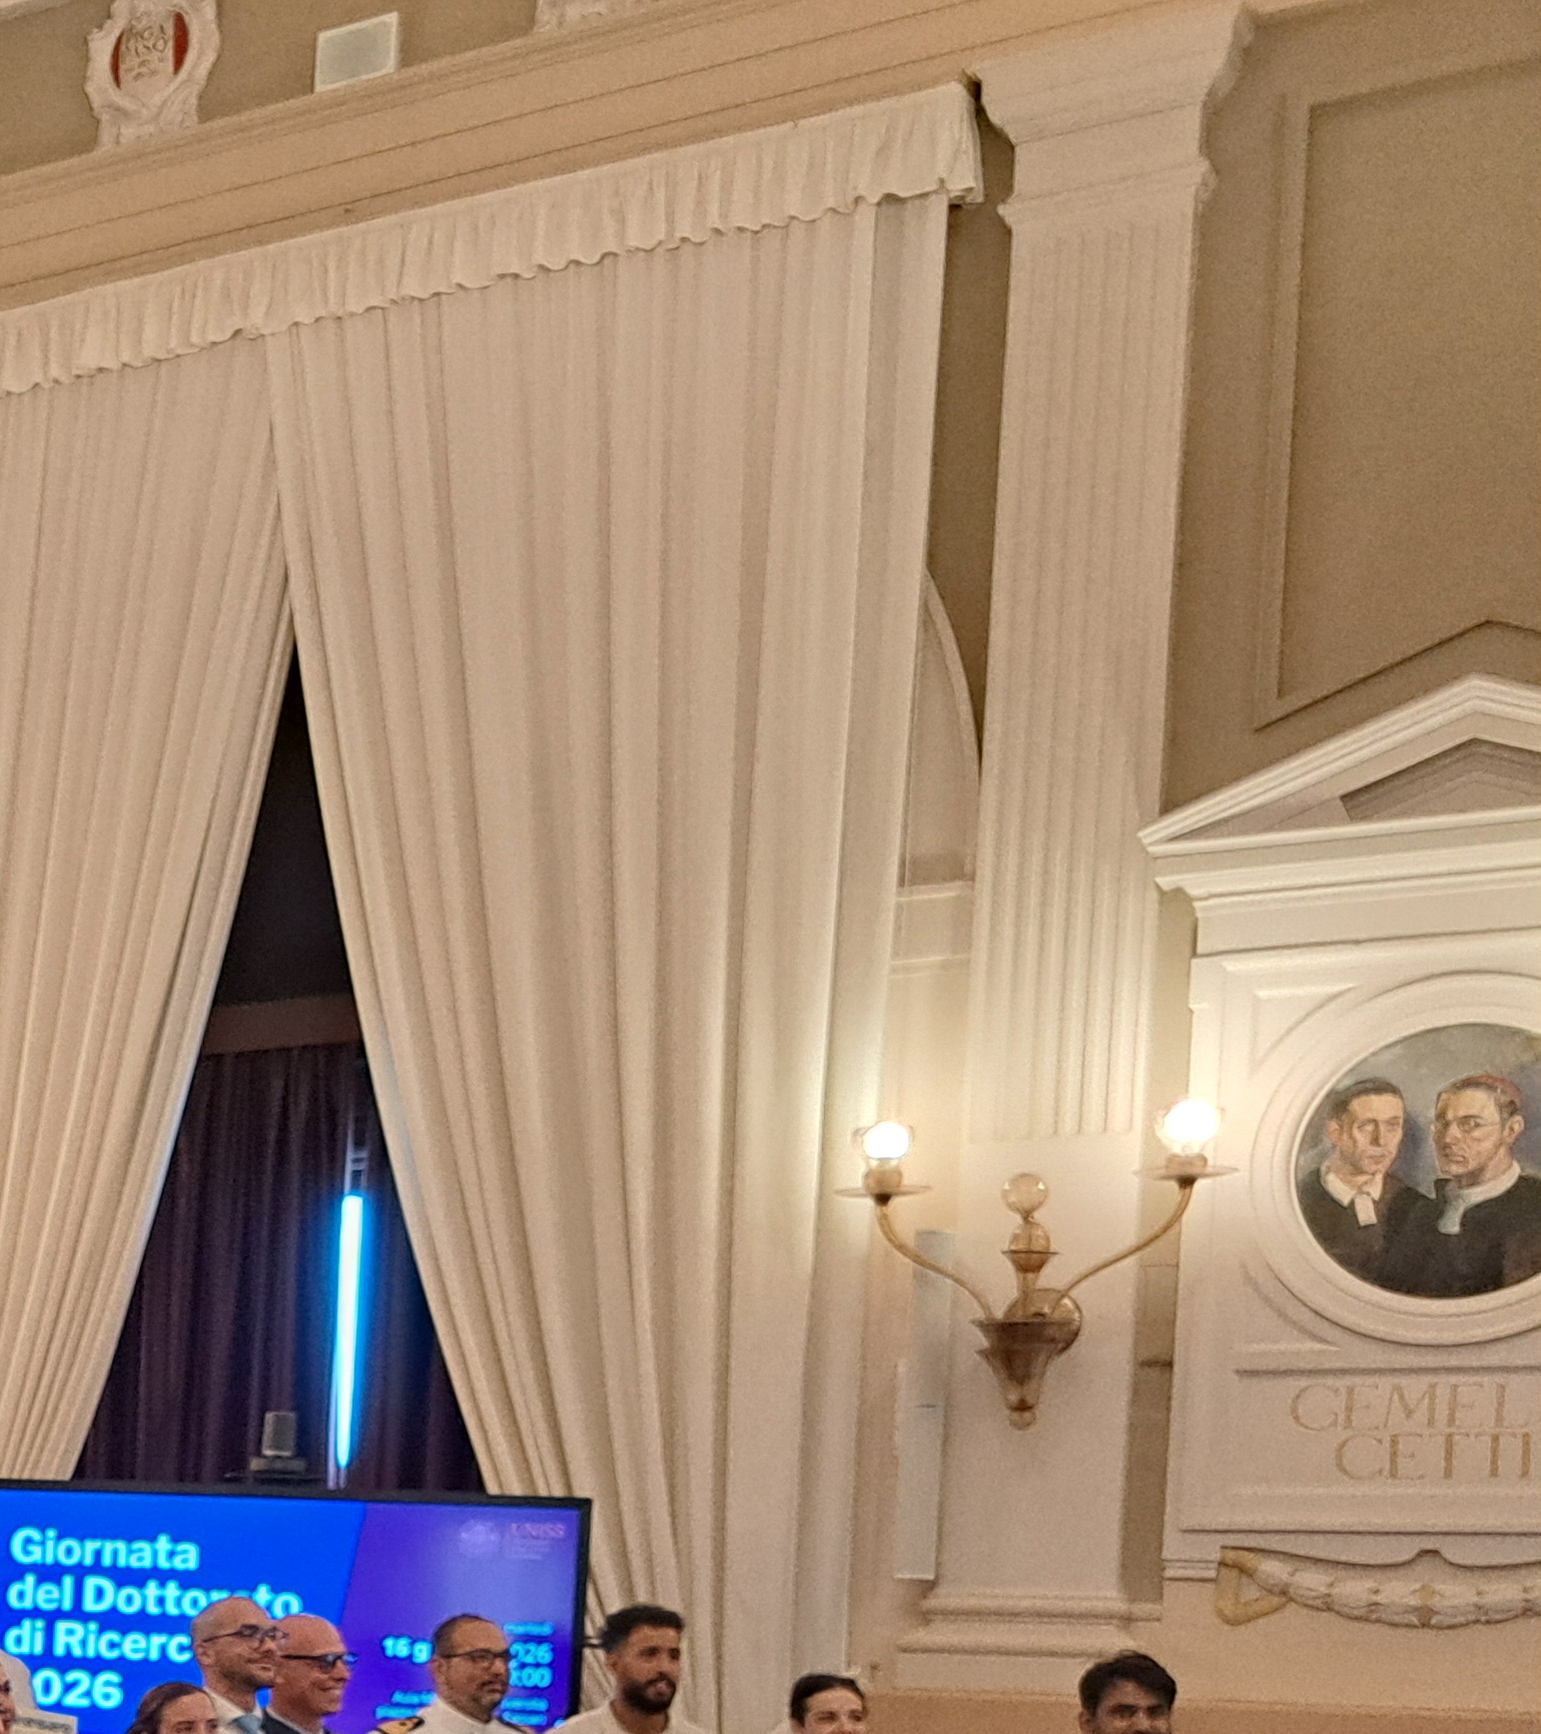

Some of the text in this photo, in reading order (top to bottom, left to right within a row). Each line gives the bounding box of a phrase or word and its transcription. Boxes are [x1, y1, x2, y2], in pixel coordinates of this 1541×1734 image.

[11, 1526, 200, 1571] Giornata
[7, 1573, 304, 1621] del Dottoto
[4, 1618, 194, 1664] di Ricerc
[32, 1667, 124, 1709] 026
